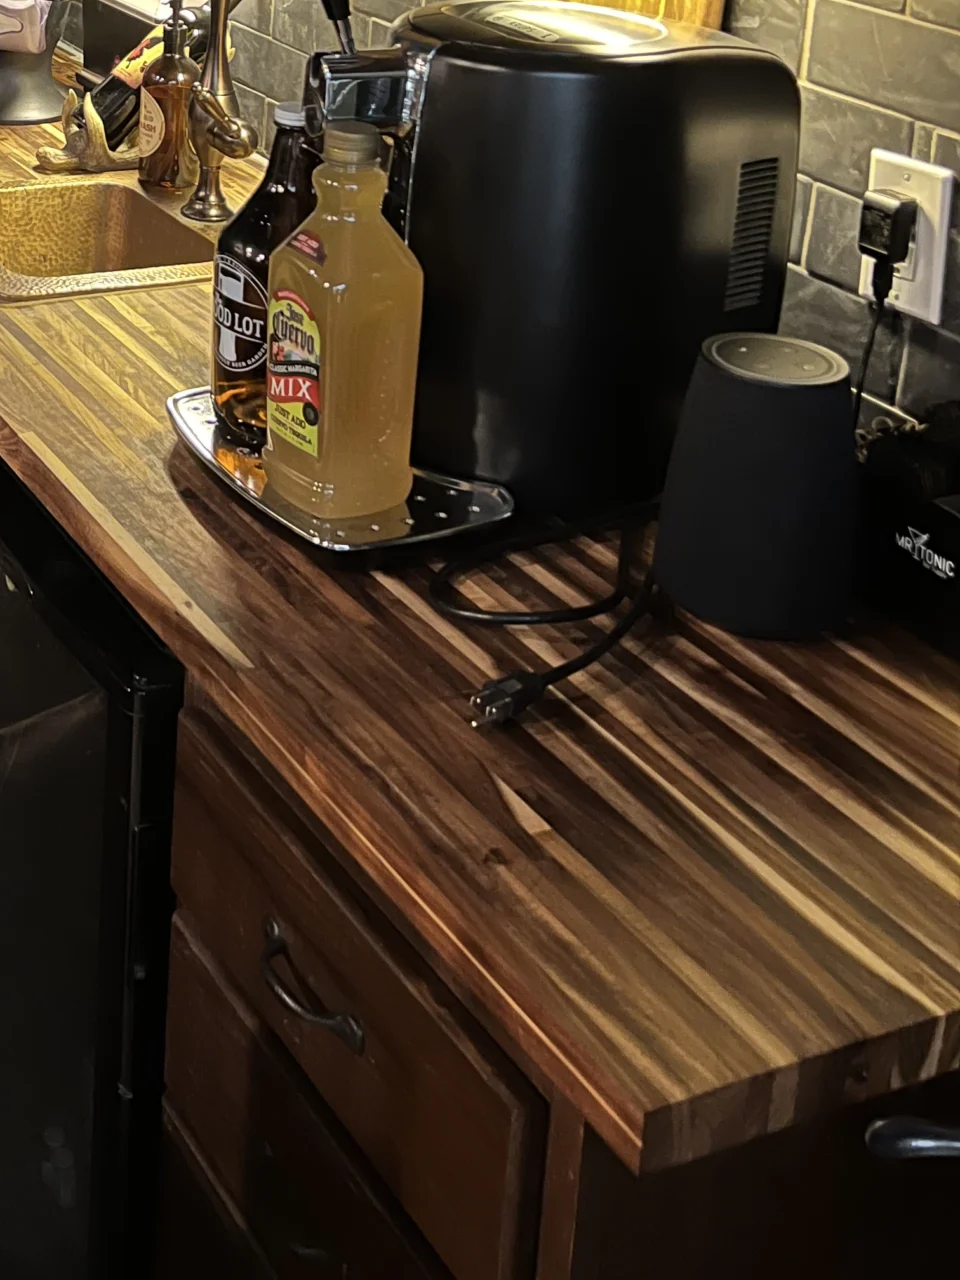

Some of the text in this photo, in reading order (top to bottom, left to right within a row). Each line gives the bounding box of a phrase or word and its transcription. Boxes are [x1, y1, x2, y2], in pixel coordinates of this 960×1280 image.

[234, 312, 265, 338] LOT
[272, 310, 315, 355] Cuervo
[270, 377, 313, 401] MIX
[274, 403, 306, 430] JUST ADD
[895, 531, 913, 552] MR
[919, 544, 956, 578] TONIC
